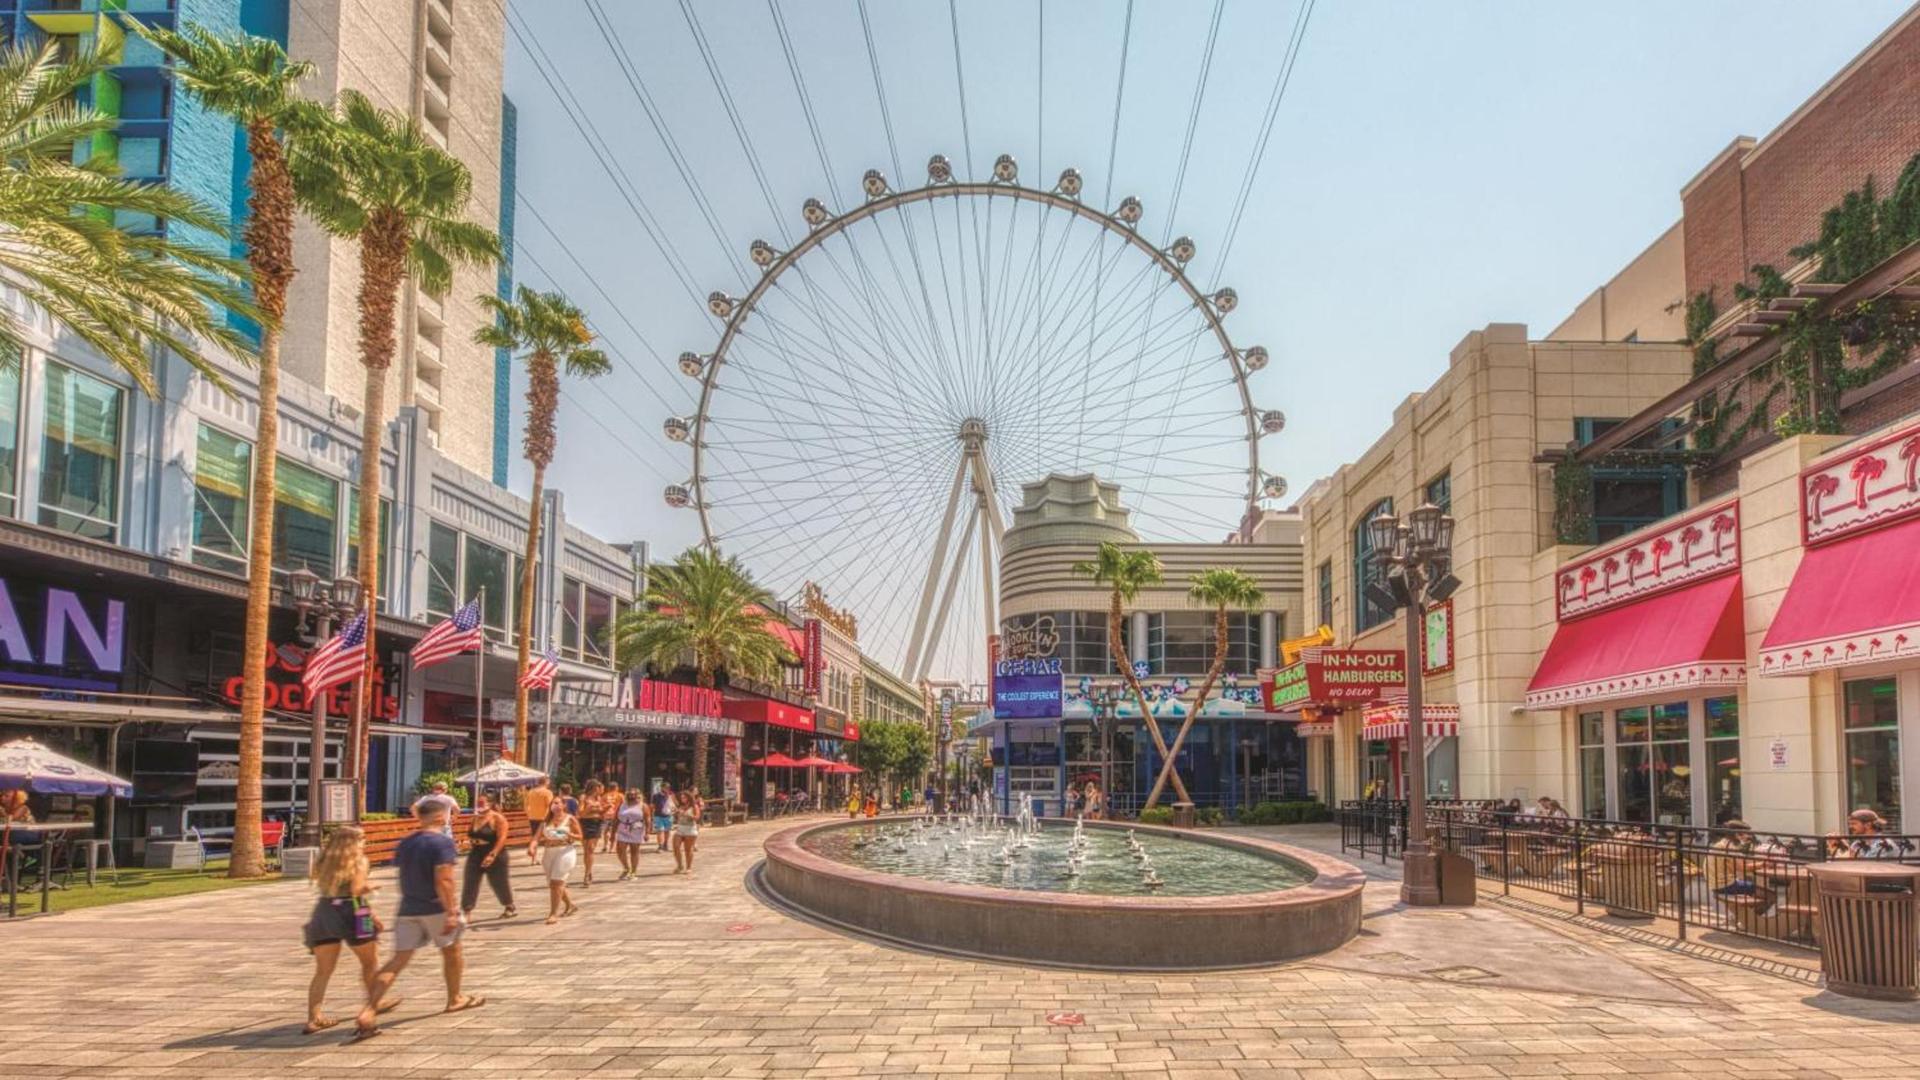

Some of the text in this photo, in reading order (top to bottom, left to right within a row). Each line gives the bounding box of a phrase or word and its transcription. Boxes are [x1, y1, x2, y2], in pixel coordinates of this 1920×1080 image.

[1323, 654, 1396, 667] IN-N-OUT
[1323, 669, 1404, 684] HAMBURGERS
[1329, 687, 1374, 697] NO DELAY
[615, 713, 661, 725] SUSHI
